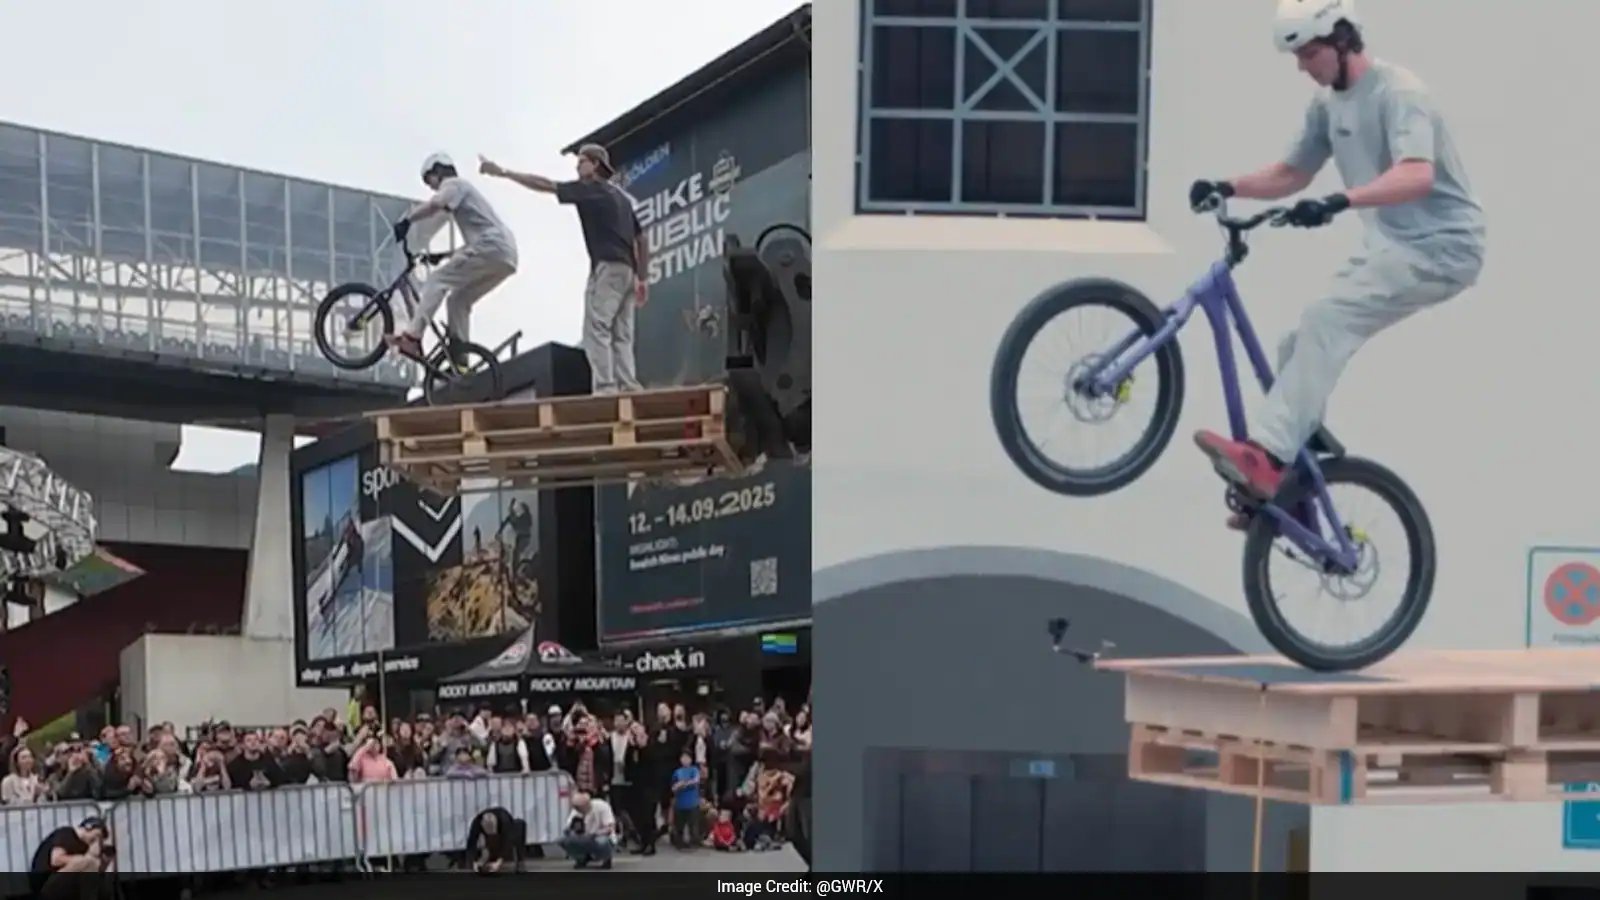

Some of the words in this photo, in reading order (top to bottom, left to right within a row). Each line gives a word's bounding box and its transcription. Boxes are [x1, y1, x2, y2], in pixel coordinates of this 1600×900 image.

[648, 195, 731, 254] UBLIC
[636, 648, 686, 673] check
[688, 646, 705, 668] in
[530, 678, 572, 692] ROCKY
[574, 677, 636, 691] MOUNTAIN
